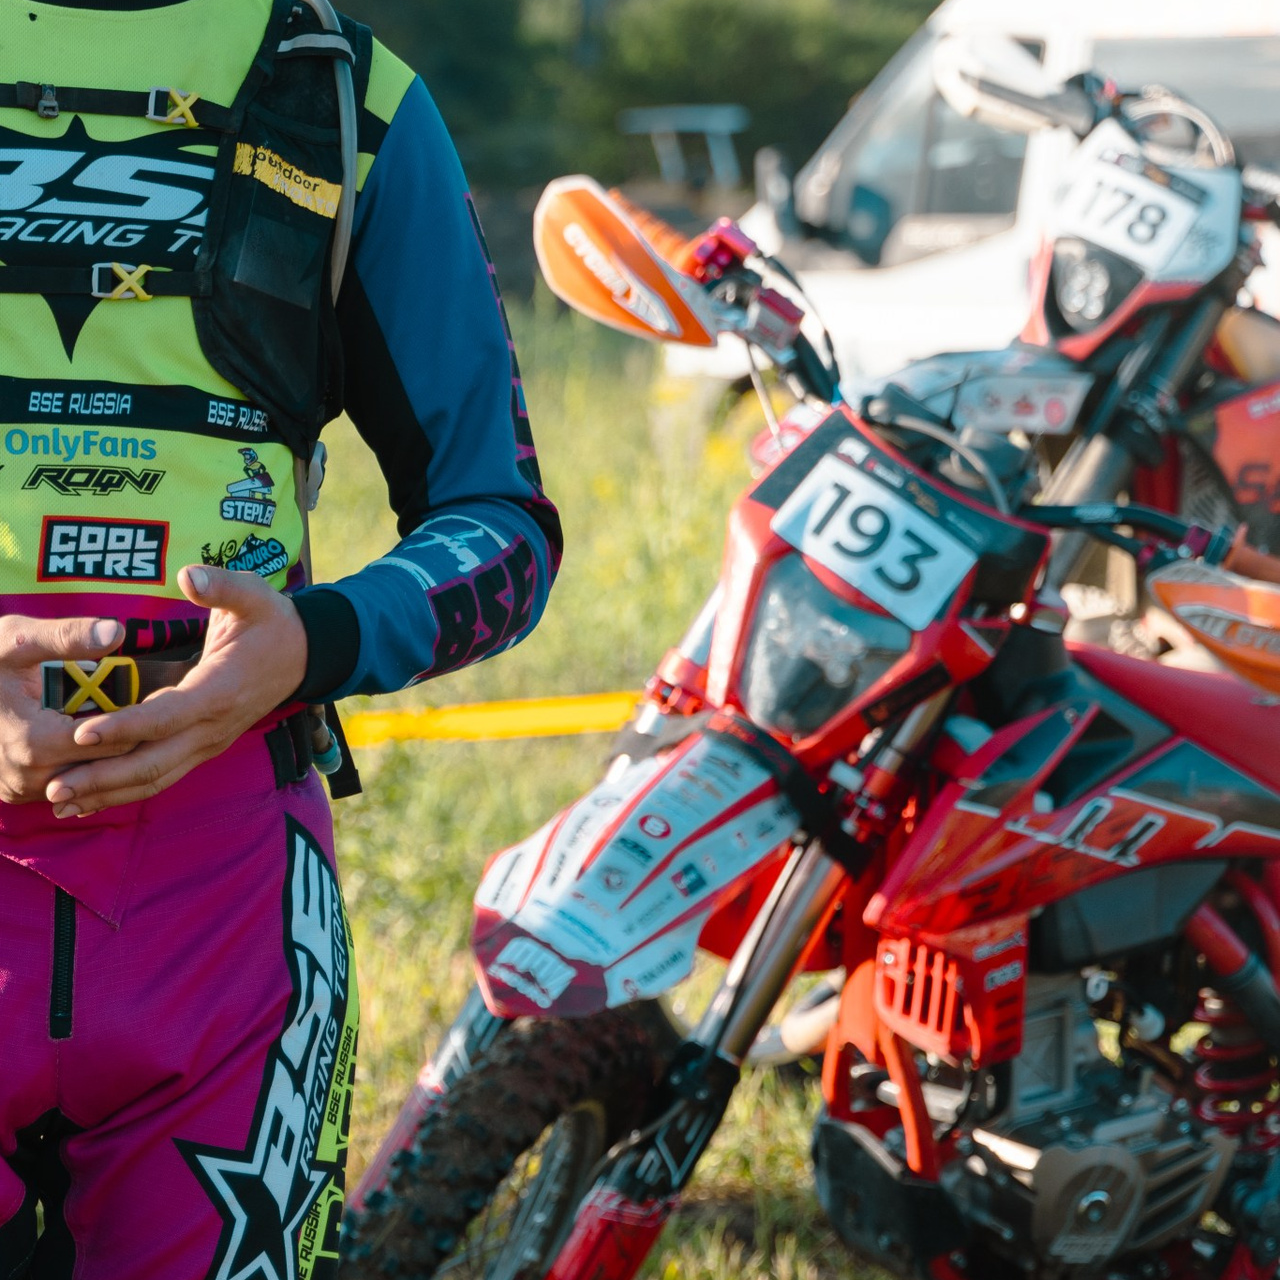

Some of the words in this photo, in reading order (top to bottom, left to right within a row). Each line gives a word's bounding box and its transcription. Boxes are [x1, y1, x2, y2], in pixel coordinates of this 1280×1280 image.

[256, 151, 320, 192] outdoor
[167, 228, 203, 256] T
[28, 391, 64, 415] BSE
[68, 391, 132, 416] RUSSIA
[207, 400, 236, 429] BSE
[4, 428, 158, 461] OnlyFans
[50, 525, 162, 553] COOL
[812, 481, 940, 593] 193
[48, 551, 158, 578] MTRS
[417, 533, 536, 678] BSE
[263, 831, 335, 1223] BSE
[300, 1017, 338, 1182] RACING
[330, 882, 347, 1001] TEAM
[326, 1090, 342, 1127] BSE
[334, 1025, 355, 1089] RUSSIA
[301, 1202, 323, 1259] RUSSIA
